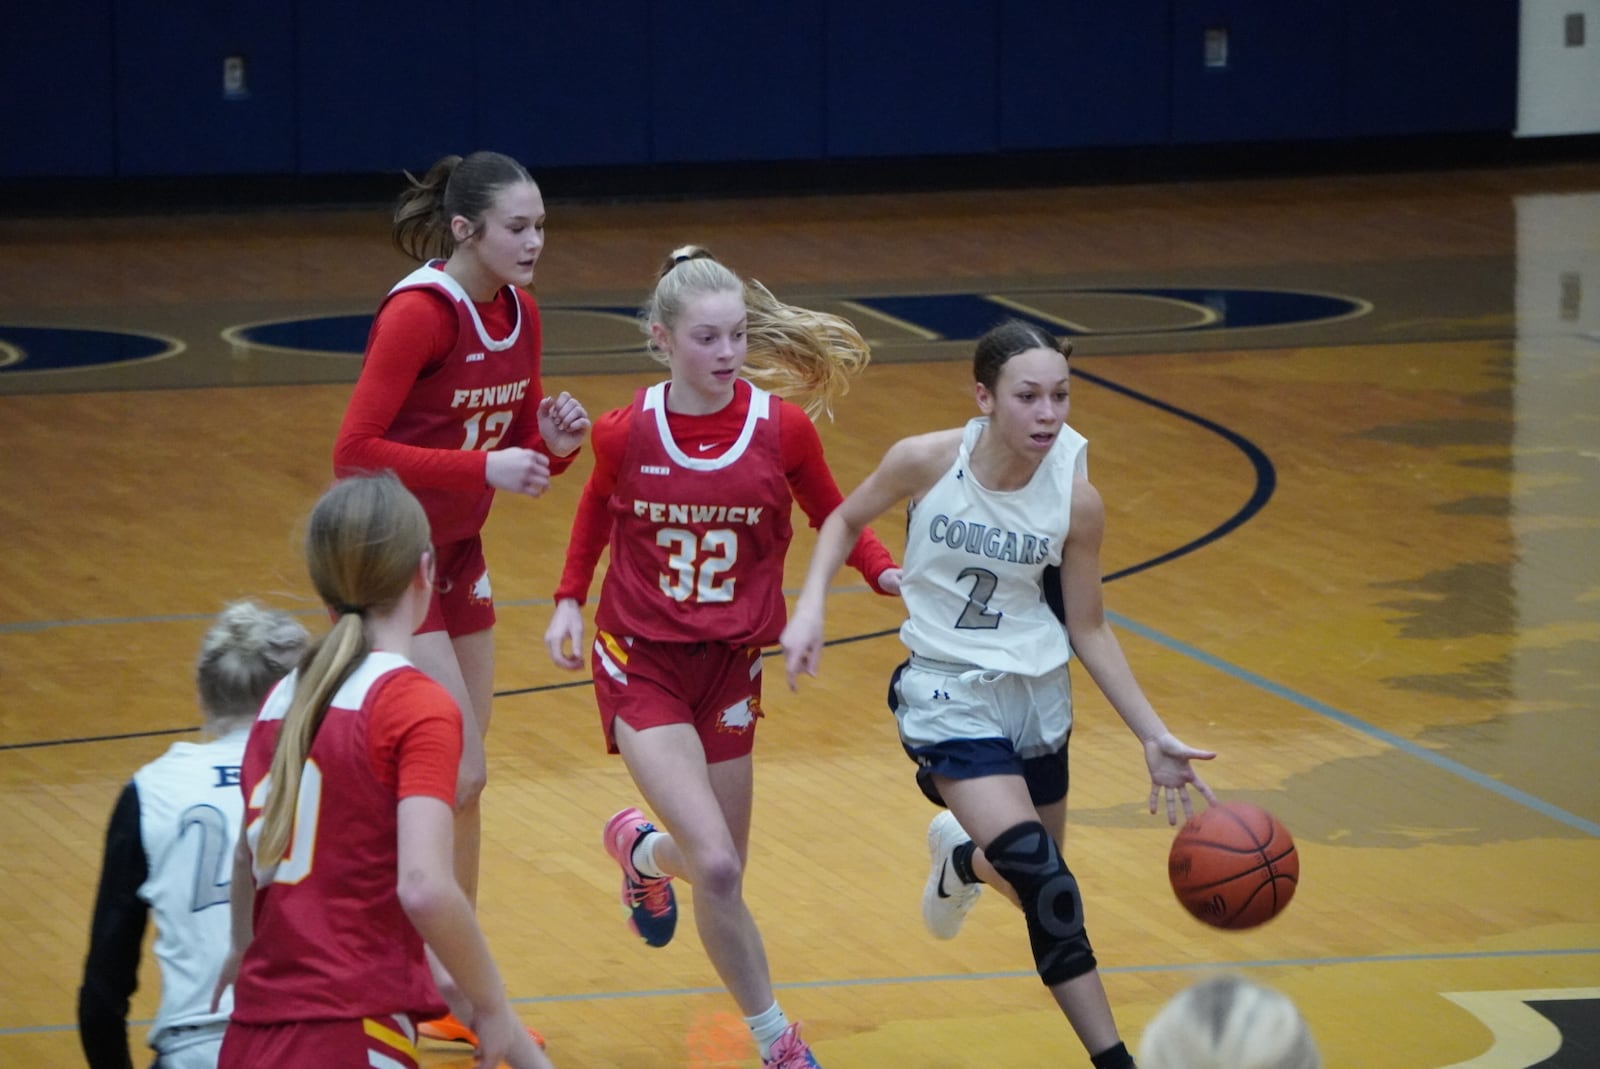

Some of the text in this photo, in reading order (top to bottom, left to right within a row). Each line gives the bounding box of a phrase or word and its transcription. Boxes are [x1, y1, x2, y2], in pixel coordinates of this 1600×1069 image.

[450, 378, 530, 408] FENWIC
[460, 410, 513, 451] 12
[633, 499, 764, 526] FENWICK
[929, 513, 1049, 565] COUGARS
[656, 527, 738, 603] 32
[954, 566, 1003, 630] 2
